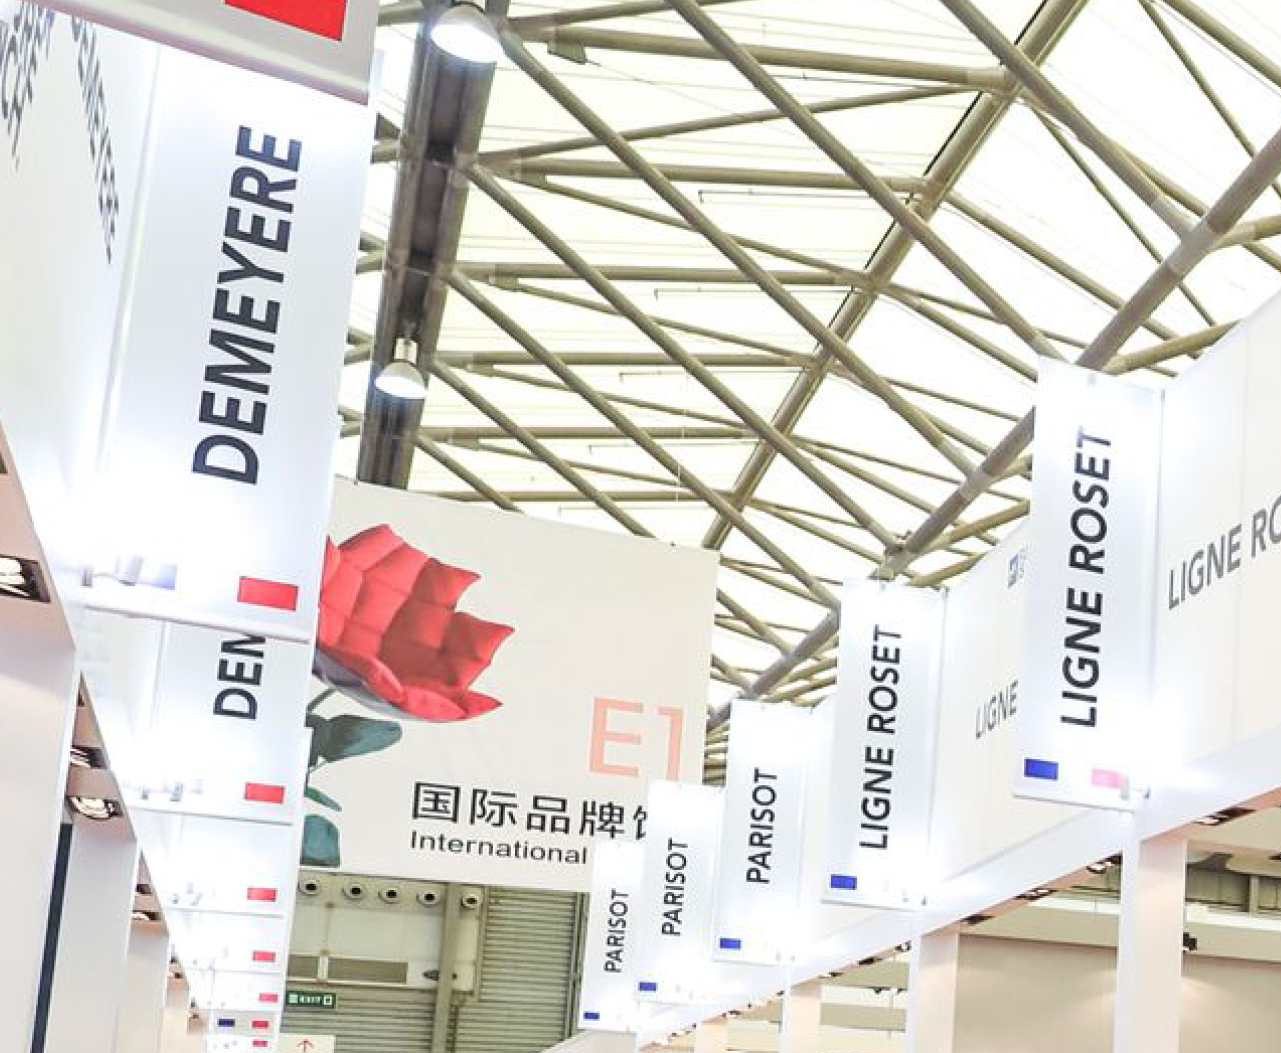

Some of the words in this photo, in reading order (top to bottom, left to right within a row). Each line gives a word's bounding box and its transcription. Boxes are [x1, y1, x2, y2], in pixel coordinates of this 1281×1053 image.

[192, 125, 302, 485] DEMEYERE
[1068, 425, 1113, 575] ROSET
[1168, 524, 1243, 611] LIGNE
[867, 624, 901, 736] ROSET
[1060, 586, 1104, 728] LIGNE
[589, 697, 686, 782] E1
[976, 680, 1019, 740] LIGNE
[410, 830, 588, 865] International
[745, 766, 779, 884] PARISOT
[859, 746, 895, 851] LIGNE
[604, 888, 630, 974] PARISOT
[661, 836, 689, 936] PARISOT
